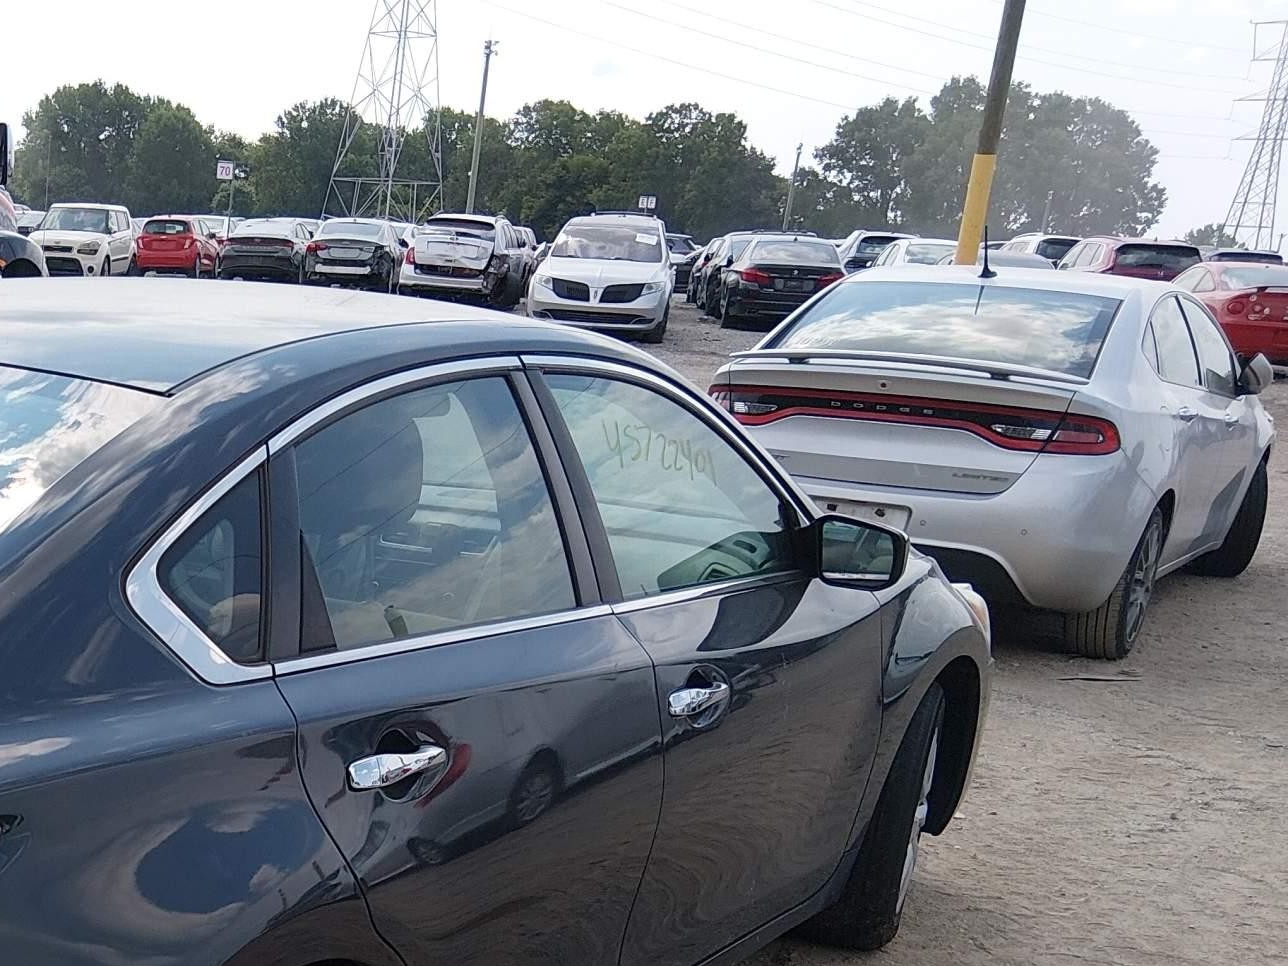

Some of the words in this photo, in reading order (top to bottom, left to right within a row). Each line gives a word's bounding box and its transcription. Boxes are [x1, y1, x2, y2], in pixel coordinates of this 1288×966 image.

[220, 166, 231, 176] 70
[831, 401, 933, 414] DODGE
[601, 419, 717, 486] 45722401
